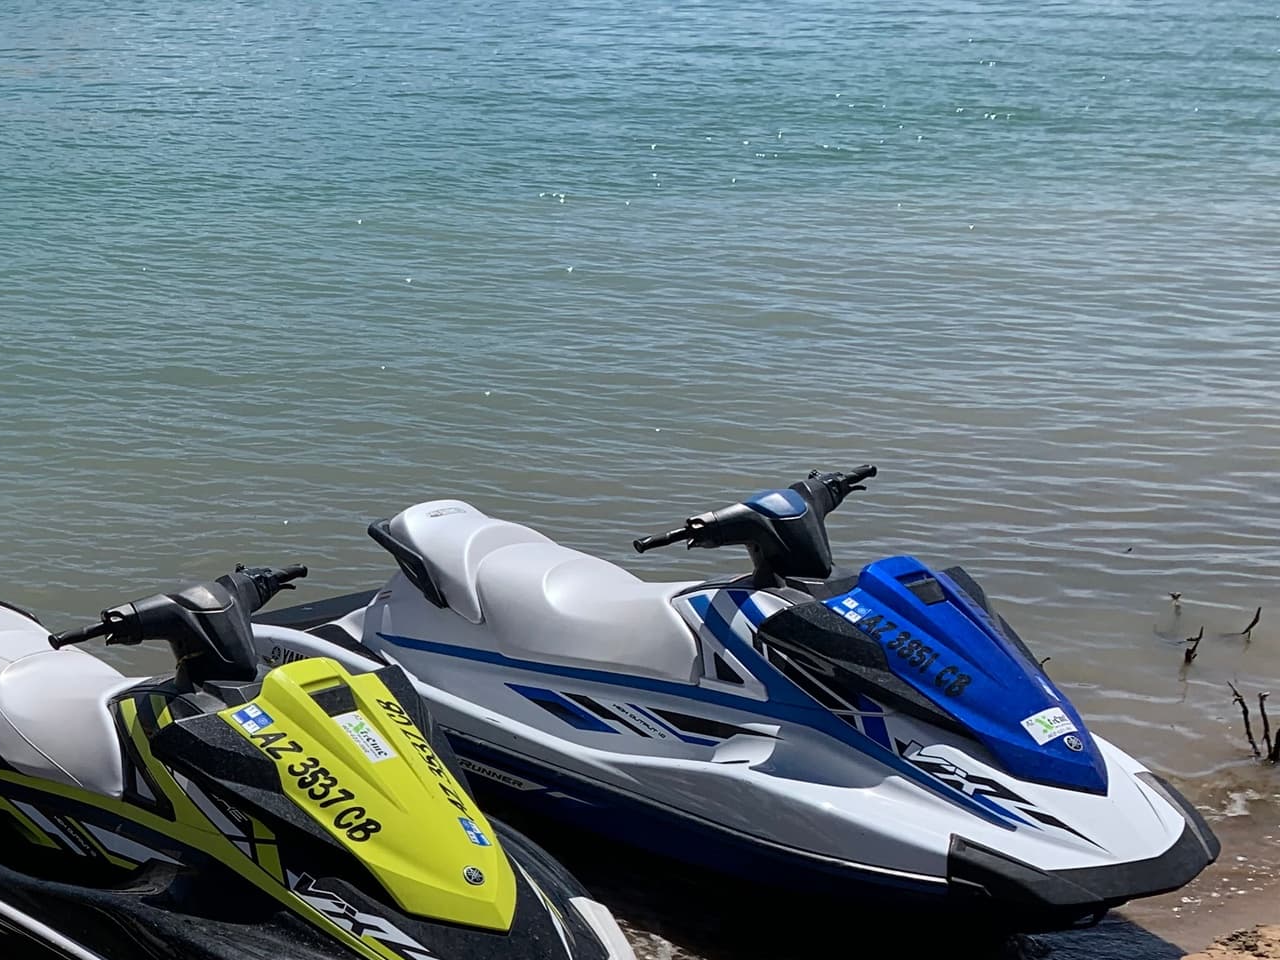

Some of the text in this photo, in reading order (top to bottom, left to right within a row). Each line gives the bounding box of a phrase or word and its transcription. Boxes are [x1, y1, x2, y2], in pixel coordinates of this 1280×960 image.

[858, 614, 898, 641] AZ
[934, 665, 972, 697] CB
[250, 733, 304, 760] AZ
[288, 757, 355, 809] 3537
[333, 806, 382, 842] CB
